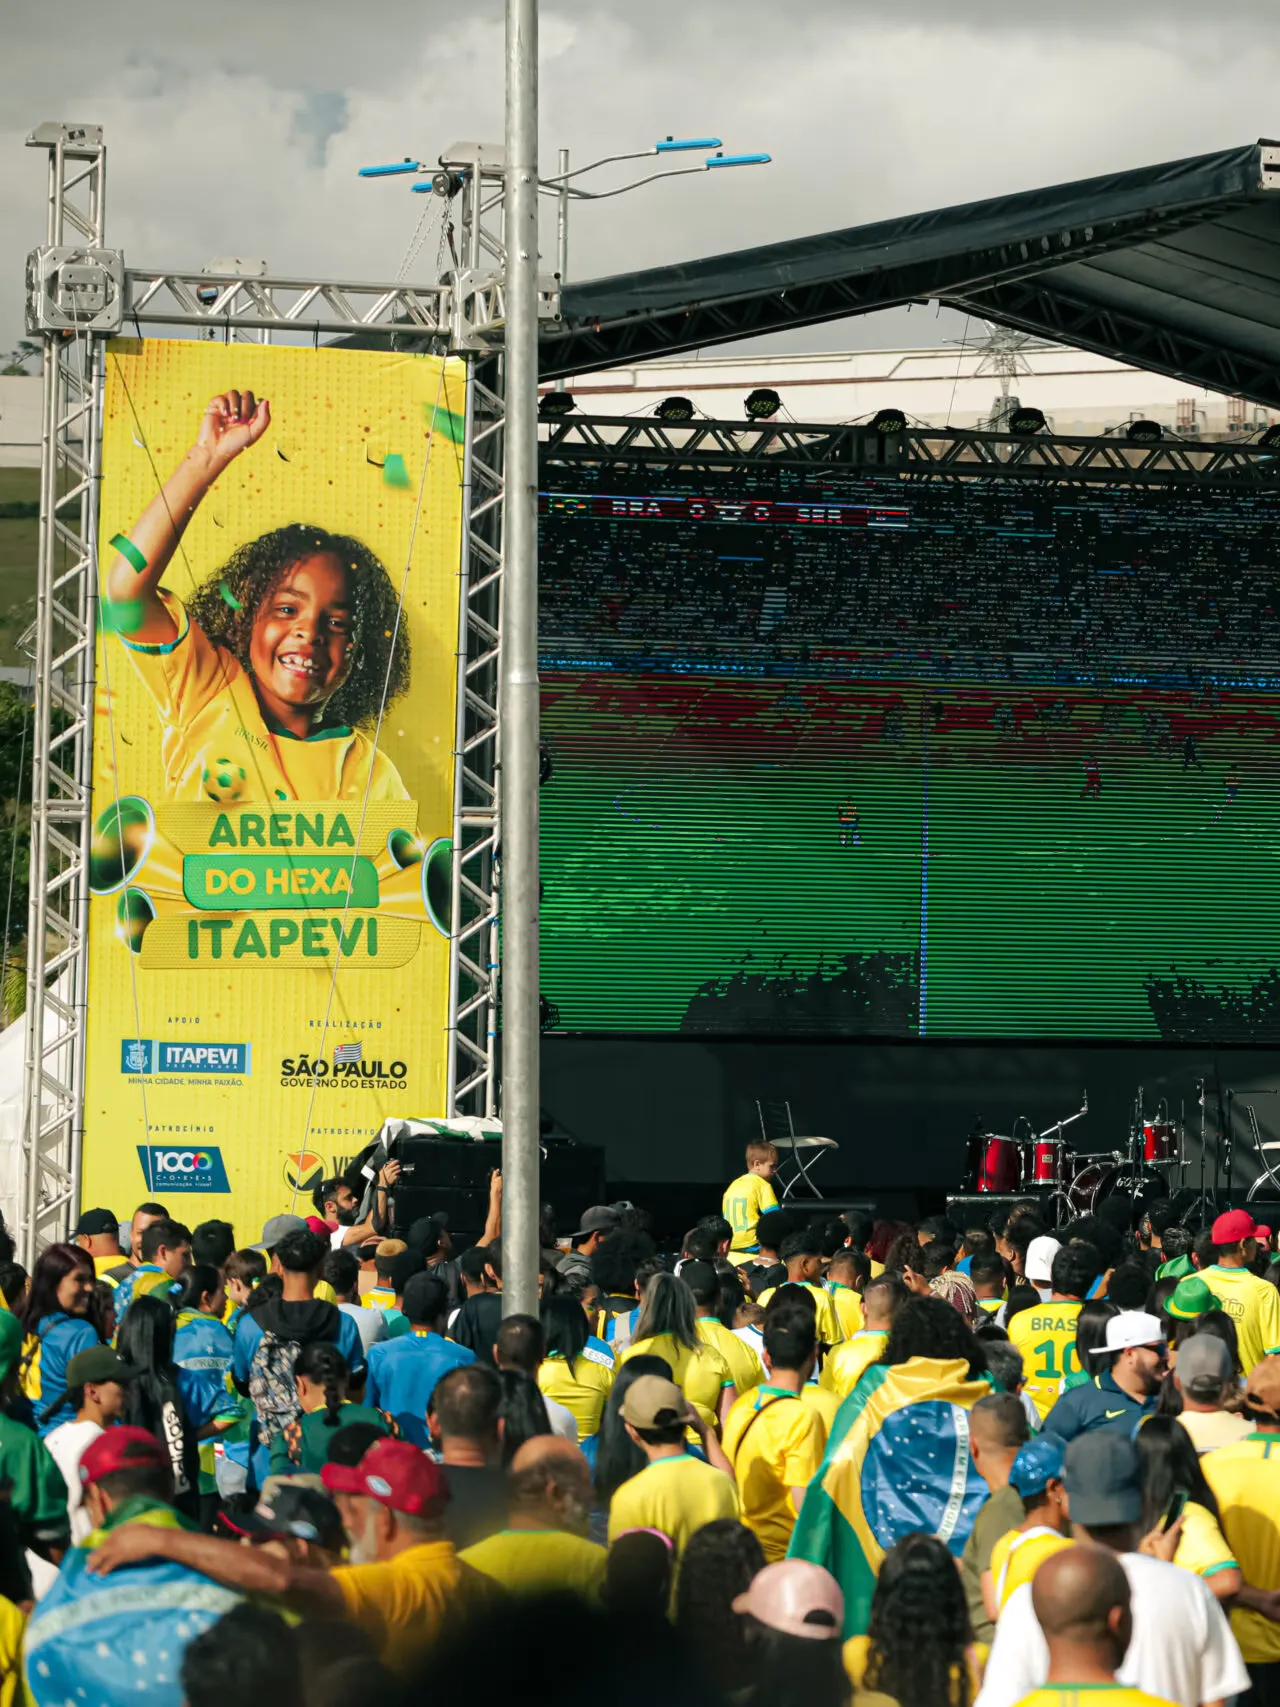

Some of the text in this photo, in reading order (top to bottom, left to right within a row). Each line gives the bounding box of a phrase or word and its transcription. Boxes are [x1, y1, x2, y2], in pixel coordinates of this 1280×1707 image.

[208, 813, 355, 847] ARENA
[205, 867, 354, 896] DO HEXA
[187, 916, 378, 959] ITAPEVI
[167, 1016, 201, 1024] APOIO
[309, 1019, 382, 1029] REALIZAÇÃO
[166, 1046, 238, 1065] ITAPEVI
[281, 1054, 408, 1079] SÃO PAULO
[128, 1077, 153, 1085] MINHA
[280, 1077, 407, 1090] GOVERNO DO ESTADO
[148, 1124, 215, 1133] PATROCÍNIO
[310, 1127, 375, 1136] PATROCÍNIO
[155, 1151, 214, 1173] 1000
[725, 1197, 748, 1232] 10
